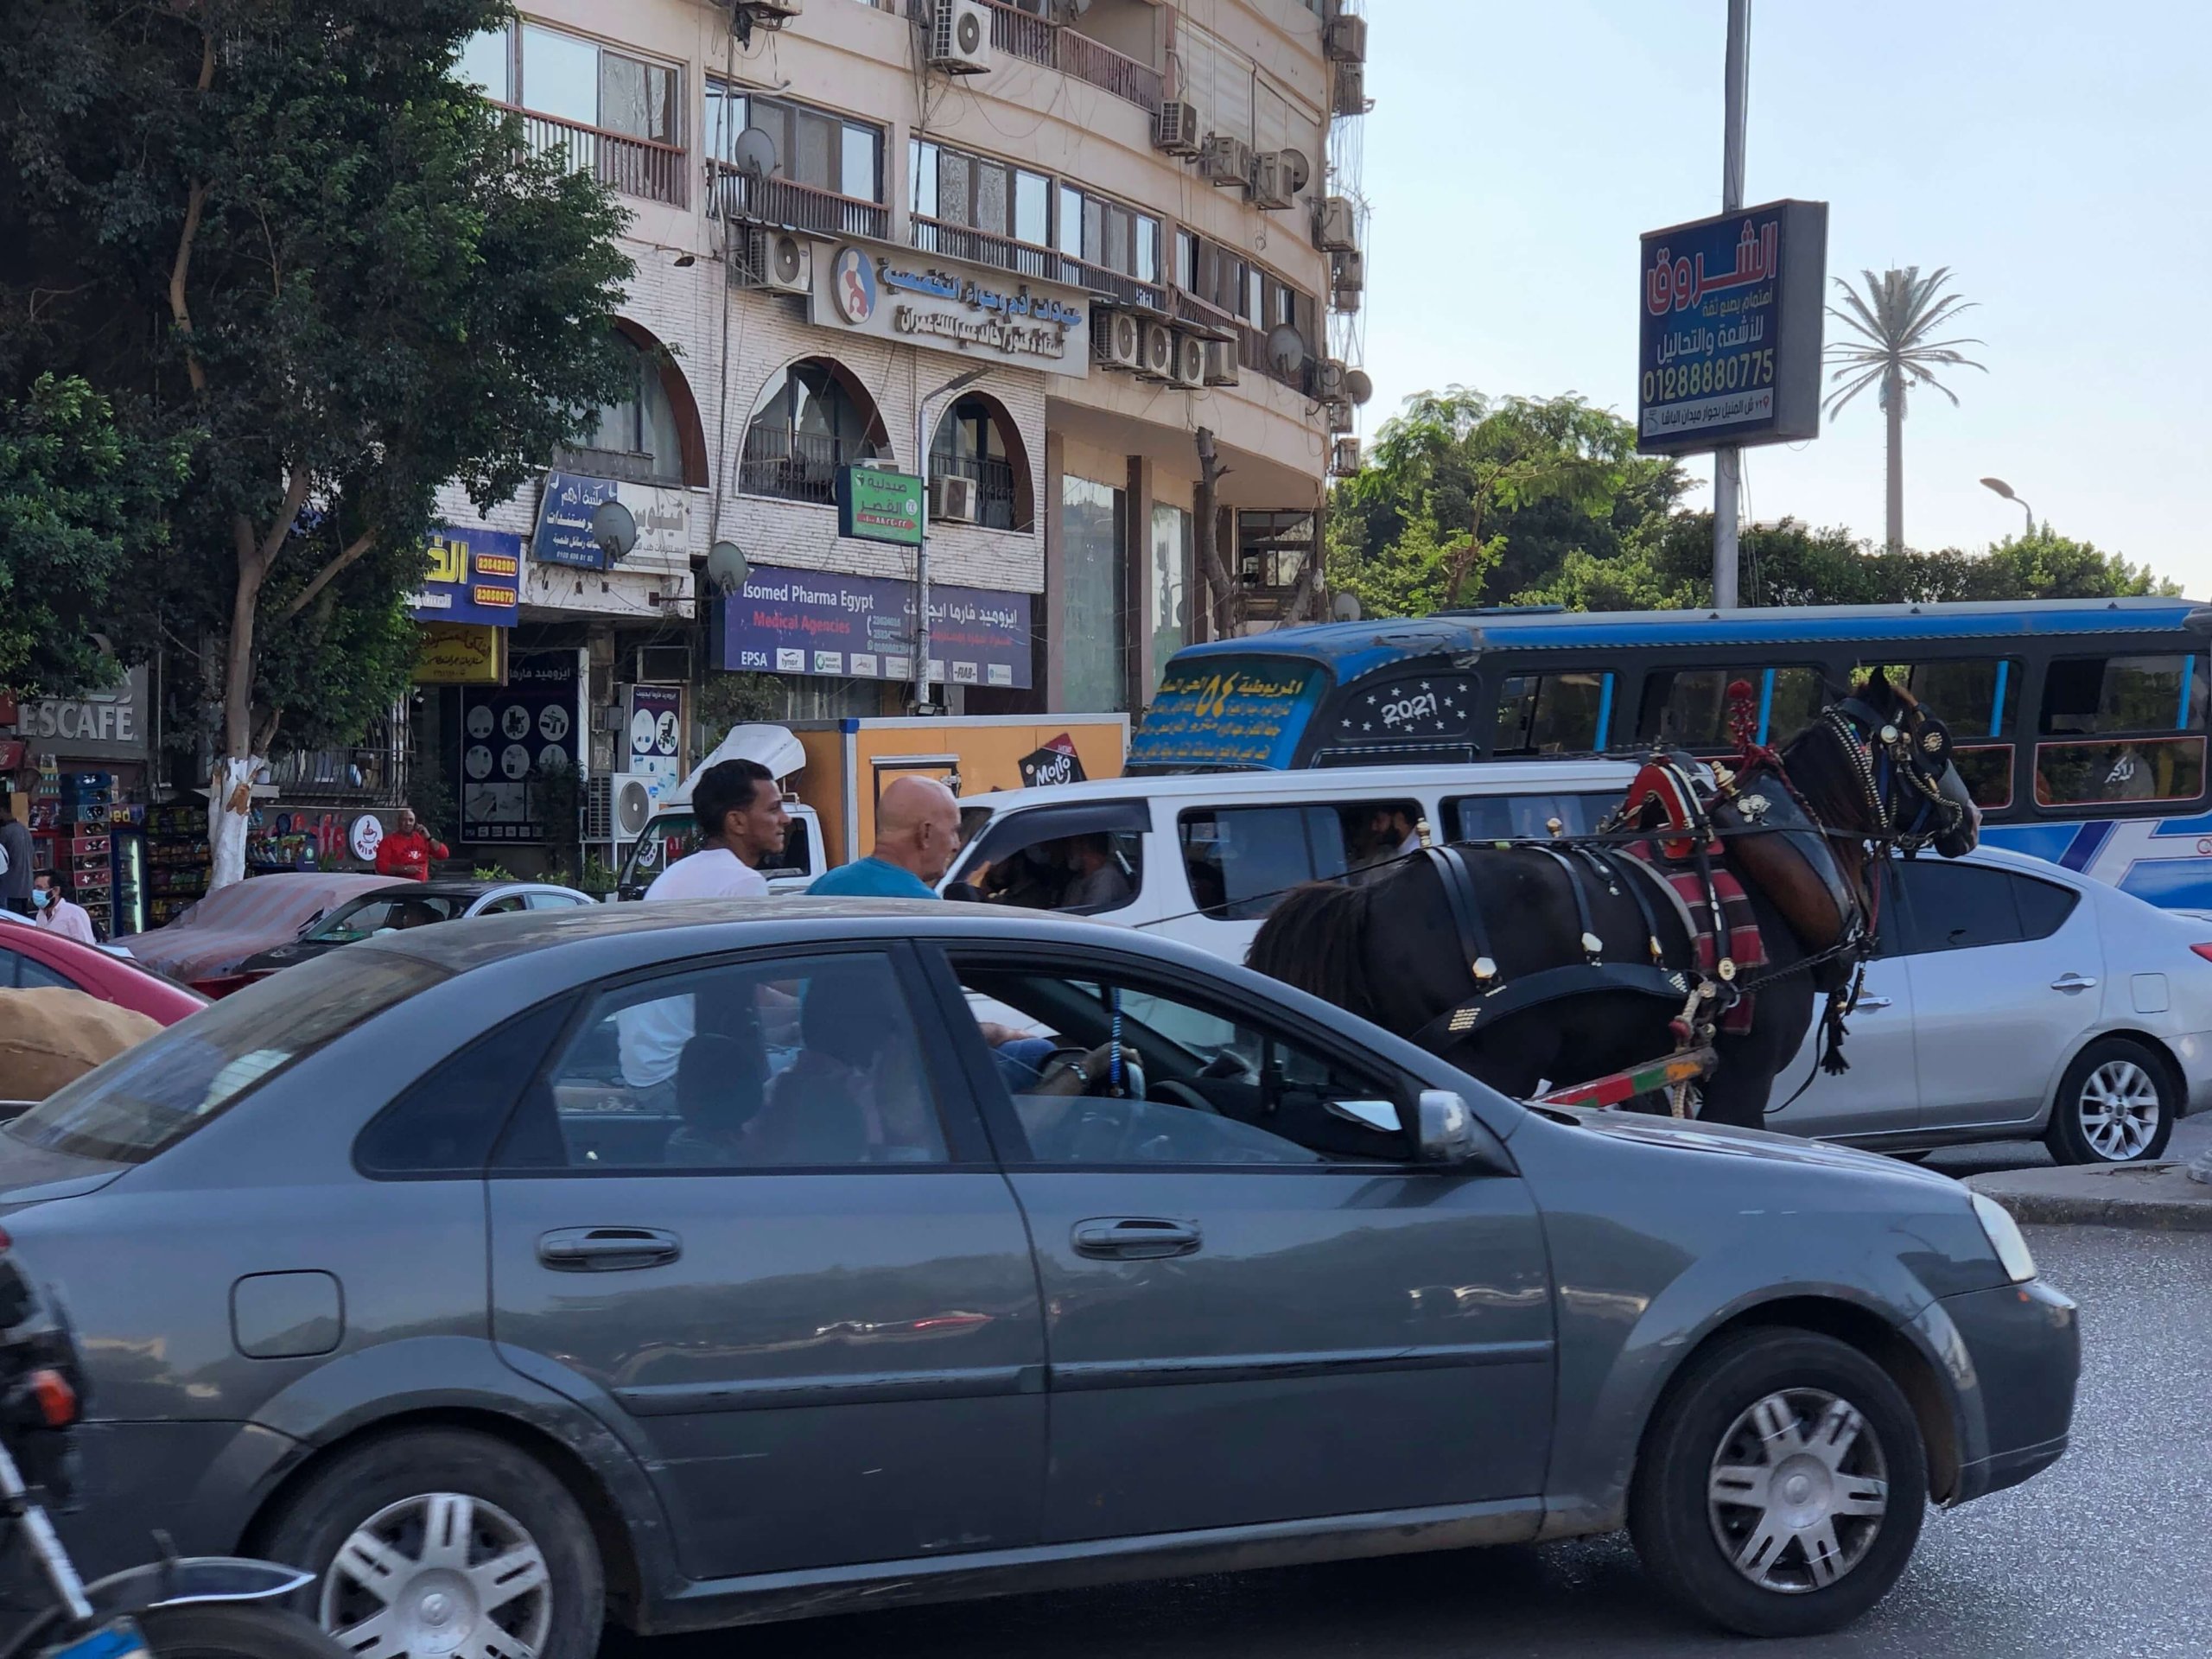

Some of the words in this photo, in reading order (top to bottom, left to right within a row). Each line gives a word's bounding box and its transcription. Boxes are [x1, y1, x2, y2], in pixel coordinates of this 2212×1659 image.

[1643, 347, 1774, 404] 01288880775
[743, 581, 788, 601] Isomed
[791, 585, 836, 606] Pharma
[841, 590, 874, 613] Egypt
[753, 611, 798, 629] Medical
[801, 615, 851, 635] Agencies
[741, 652, 768, 668] EPSA
[1381, 692, 1438, 728] 2021
[1037, 754, 1071, 787] Molto
